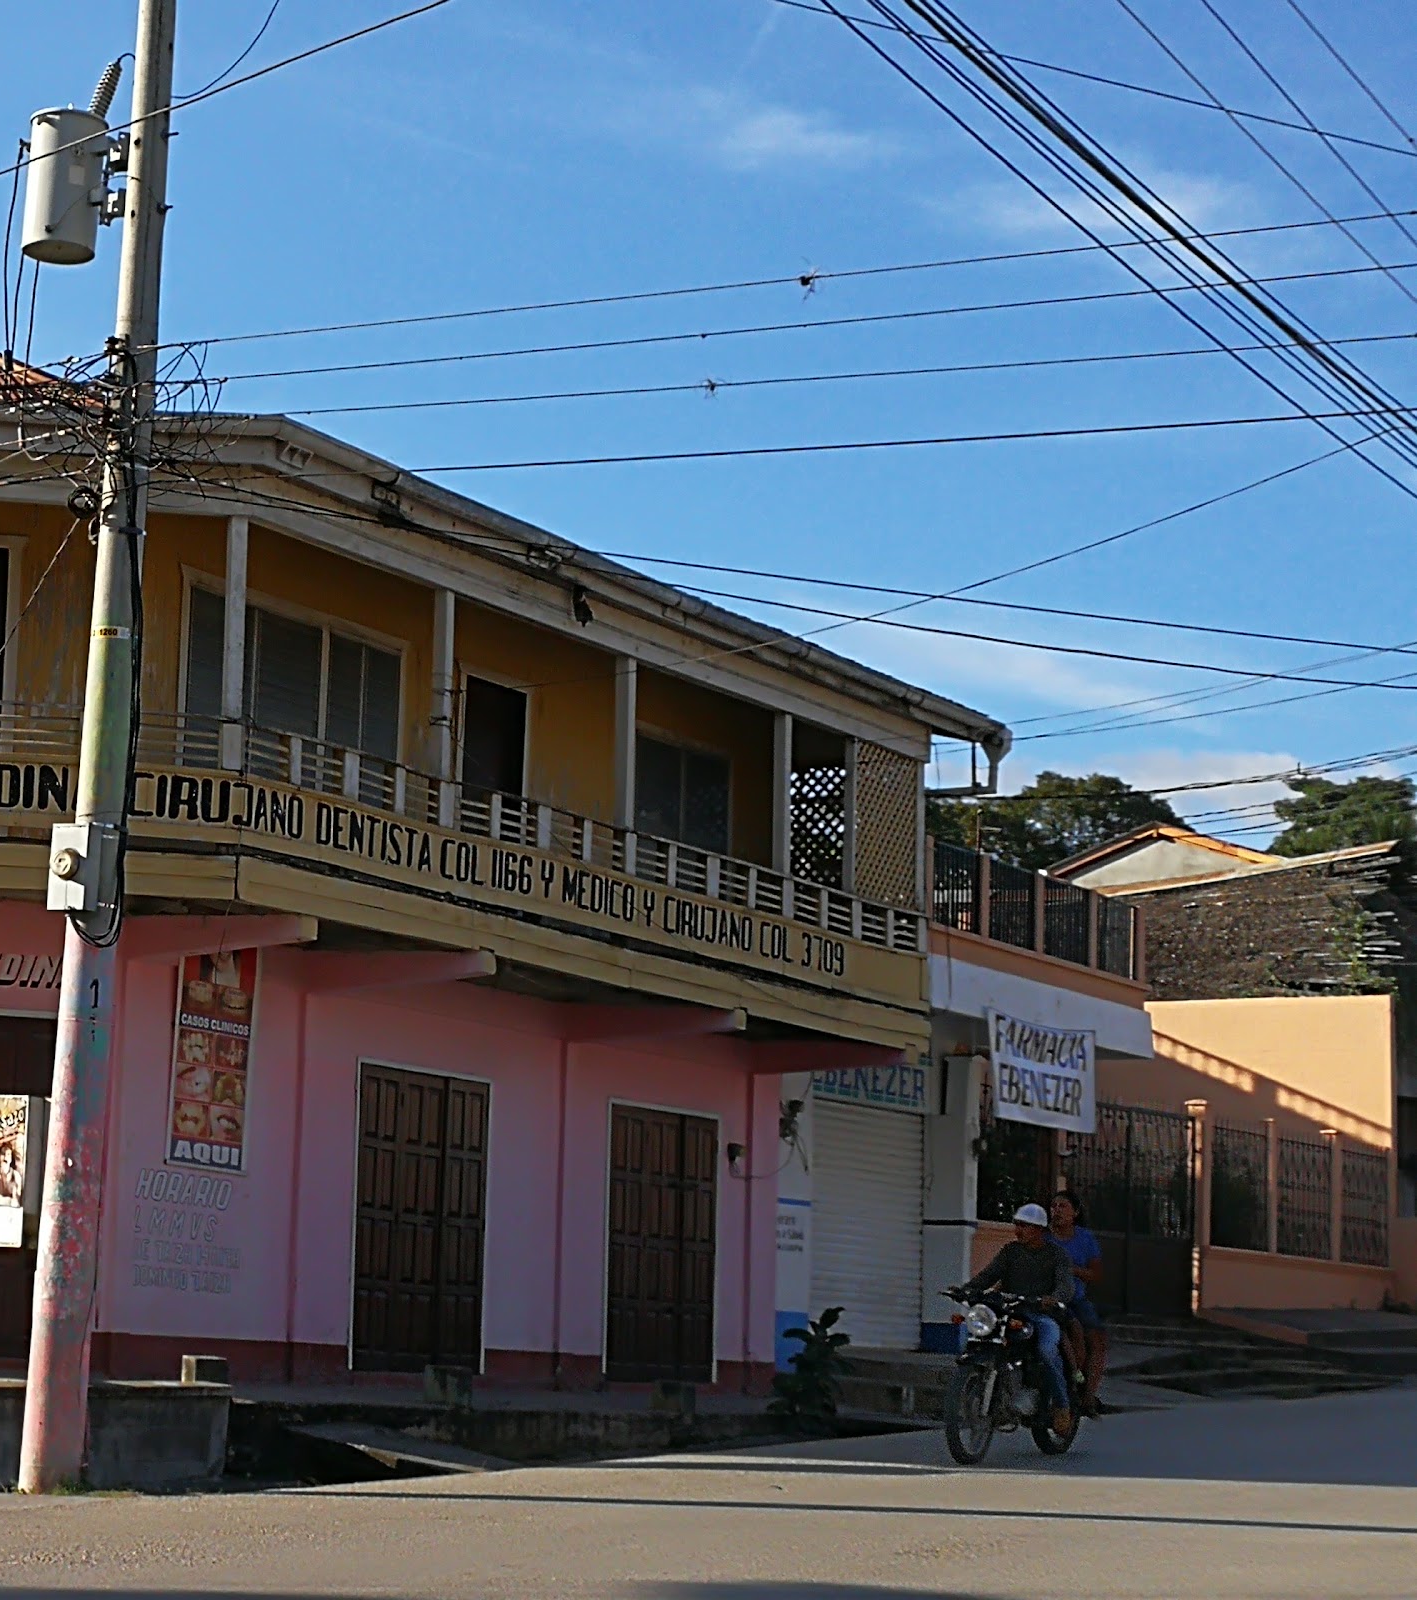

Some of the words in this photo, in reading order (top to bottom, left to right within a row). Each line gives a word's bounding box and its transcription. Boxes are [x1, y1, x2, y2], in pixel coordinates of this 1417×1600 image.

[128, 771, 303, 840] CIRUJANO
[316, 802, 431, 873] DENTISTA
[492, 848, 533, 895] 1166
[541, 860, 555, 898] Y
[562, 865, 635, 923] MEDICO
[644, 889, 656, 928] Y
[664, 895, 753, 952] CIRUJANO
[802, 932, 845, 977] 3709
[181, 1013, 209, 1029] CASOS
[211, 1019, 249, 1036] CLINICOS
[996, 1013, 1087, 1073] FARMACIA
[999, 1063, 1082, 1117] EBENEZER
[174, 1140, 240, 1167] AQUI
[134, 1167, 233, 1212] HORARIO
